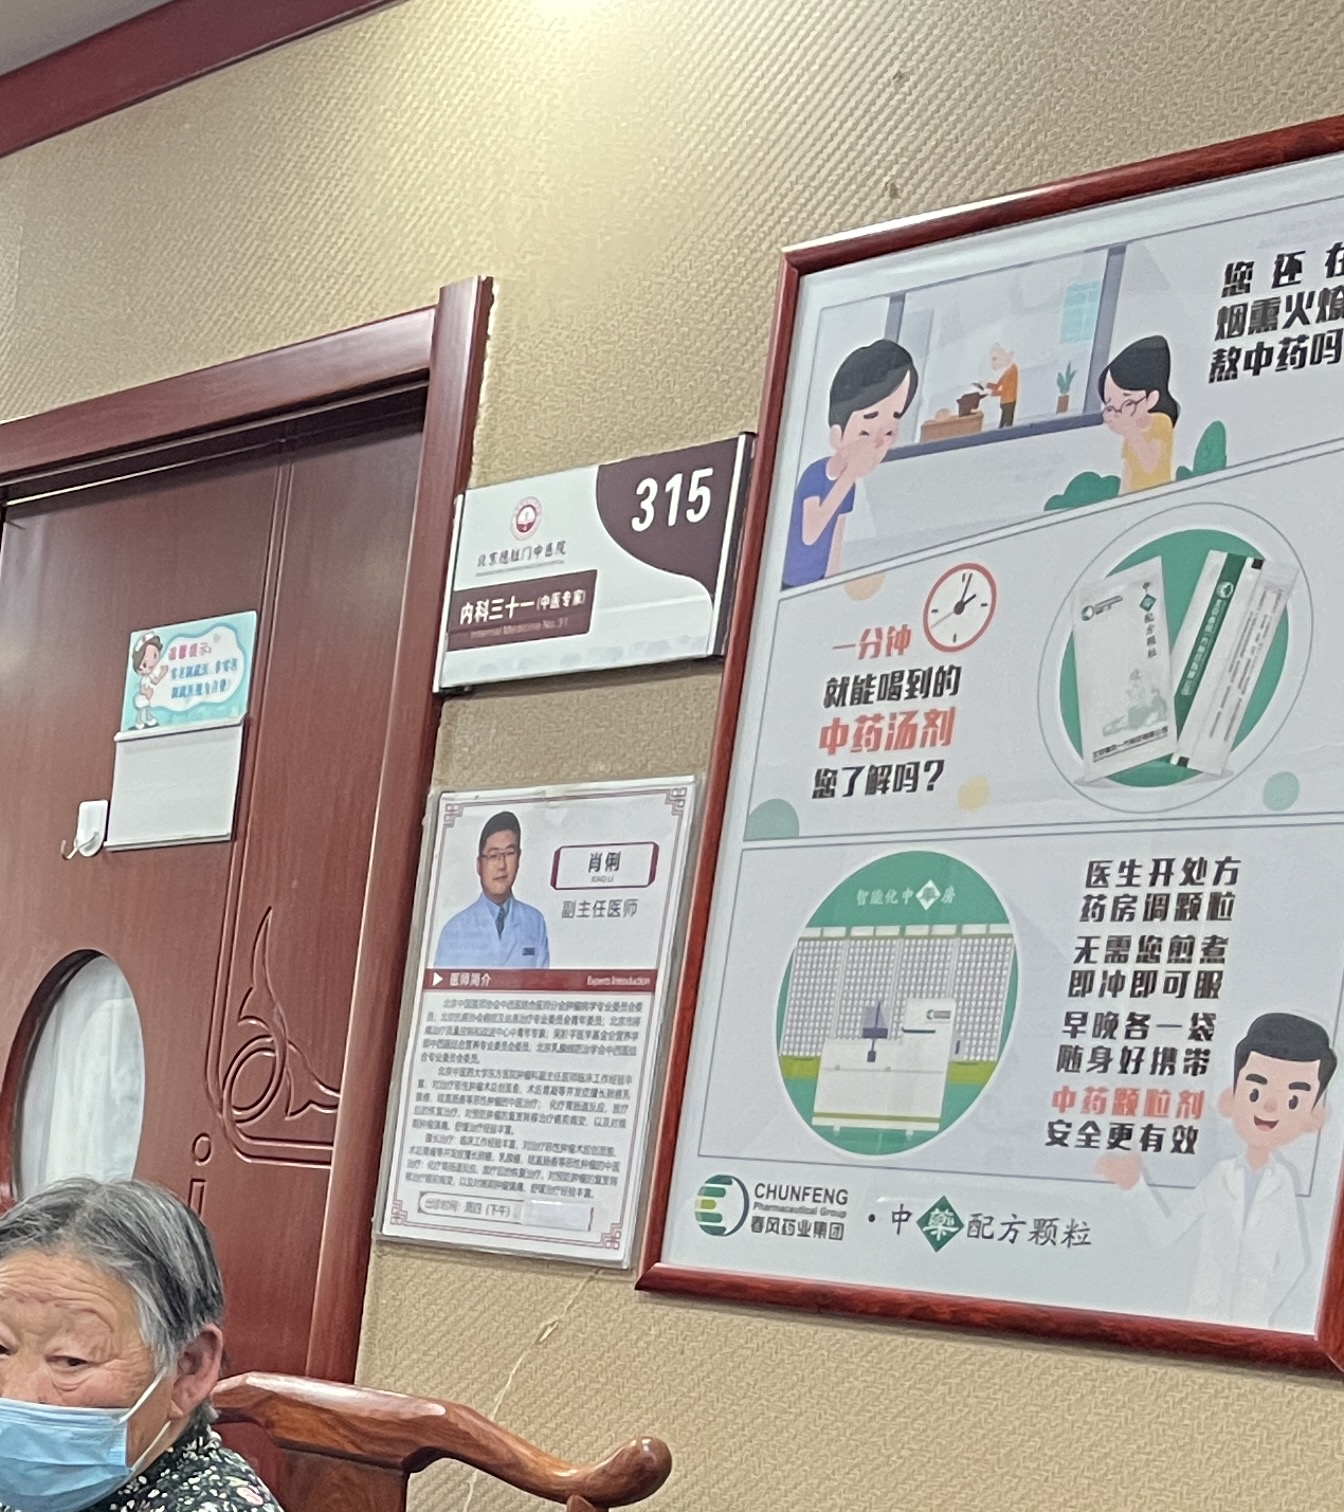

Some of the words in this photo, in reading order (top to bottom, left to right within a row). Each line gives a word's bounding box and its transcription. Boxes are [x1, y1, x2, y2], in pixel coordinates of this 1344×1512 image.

[1208, 328, 1344, 383] 熬中药吗
[631, 468, 714, 532] 315
[832, 624, 912, 660] 一分钟
[823, 664, 962, 708] 就能喝到的
[818, 706, 956, 756] 中药汤剂
[812, 759, 945, 799] 您了解吗?
[1085, 856, 1241, 888] 医生开处方
[561, 899, 639, 918] 副主任医师
[1079, 891, 1235, 922] 药房调颗粒
[1073, 934, 1229, 964] 无需您煎煮
[1067, 970, 1223, 999] 即冲即可服
[1062, 1010, 1217, 1041] 早晚各一袋
[1056, 1044, 1211, 1076] 随身好携带
[1052, 1085, 1205, 1119] 中药颗粒剂
[1045, 1119, 1198, 1155] 安全更有效
[752, 1201, 817, 1216] Pharmaceutical
[820, 1207, 847, 1219] Group
[754, 1183, 848, 1205] CHUNFENG
[751, 1216, 844, 1241] 春风药业集团
